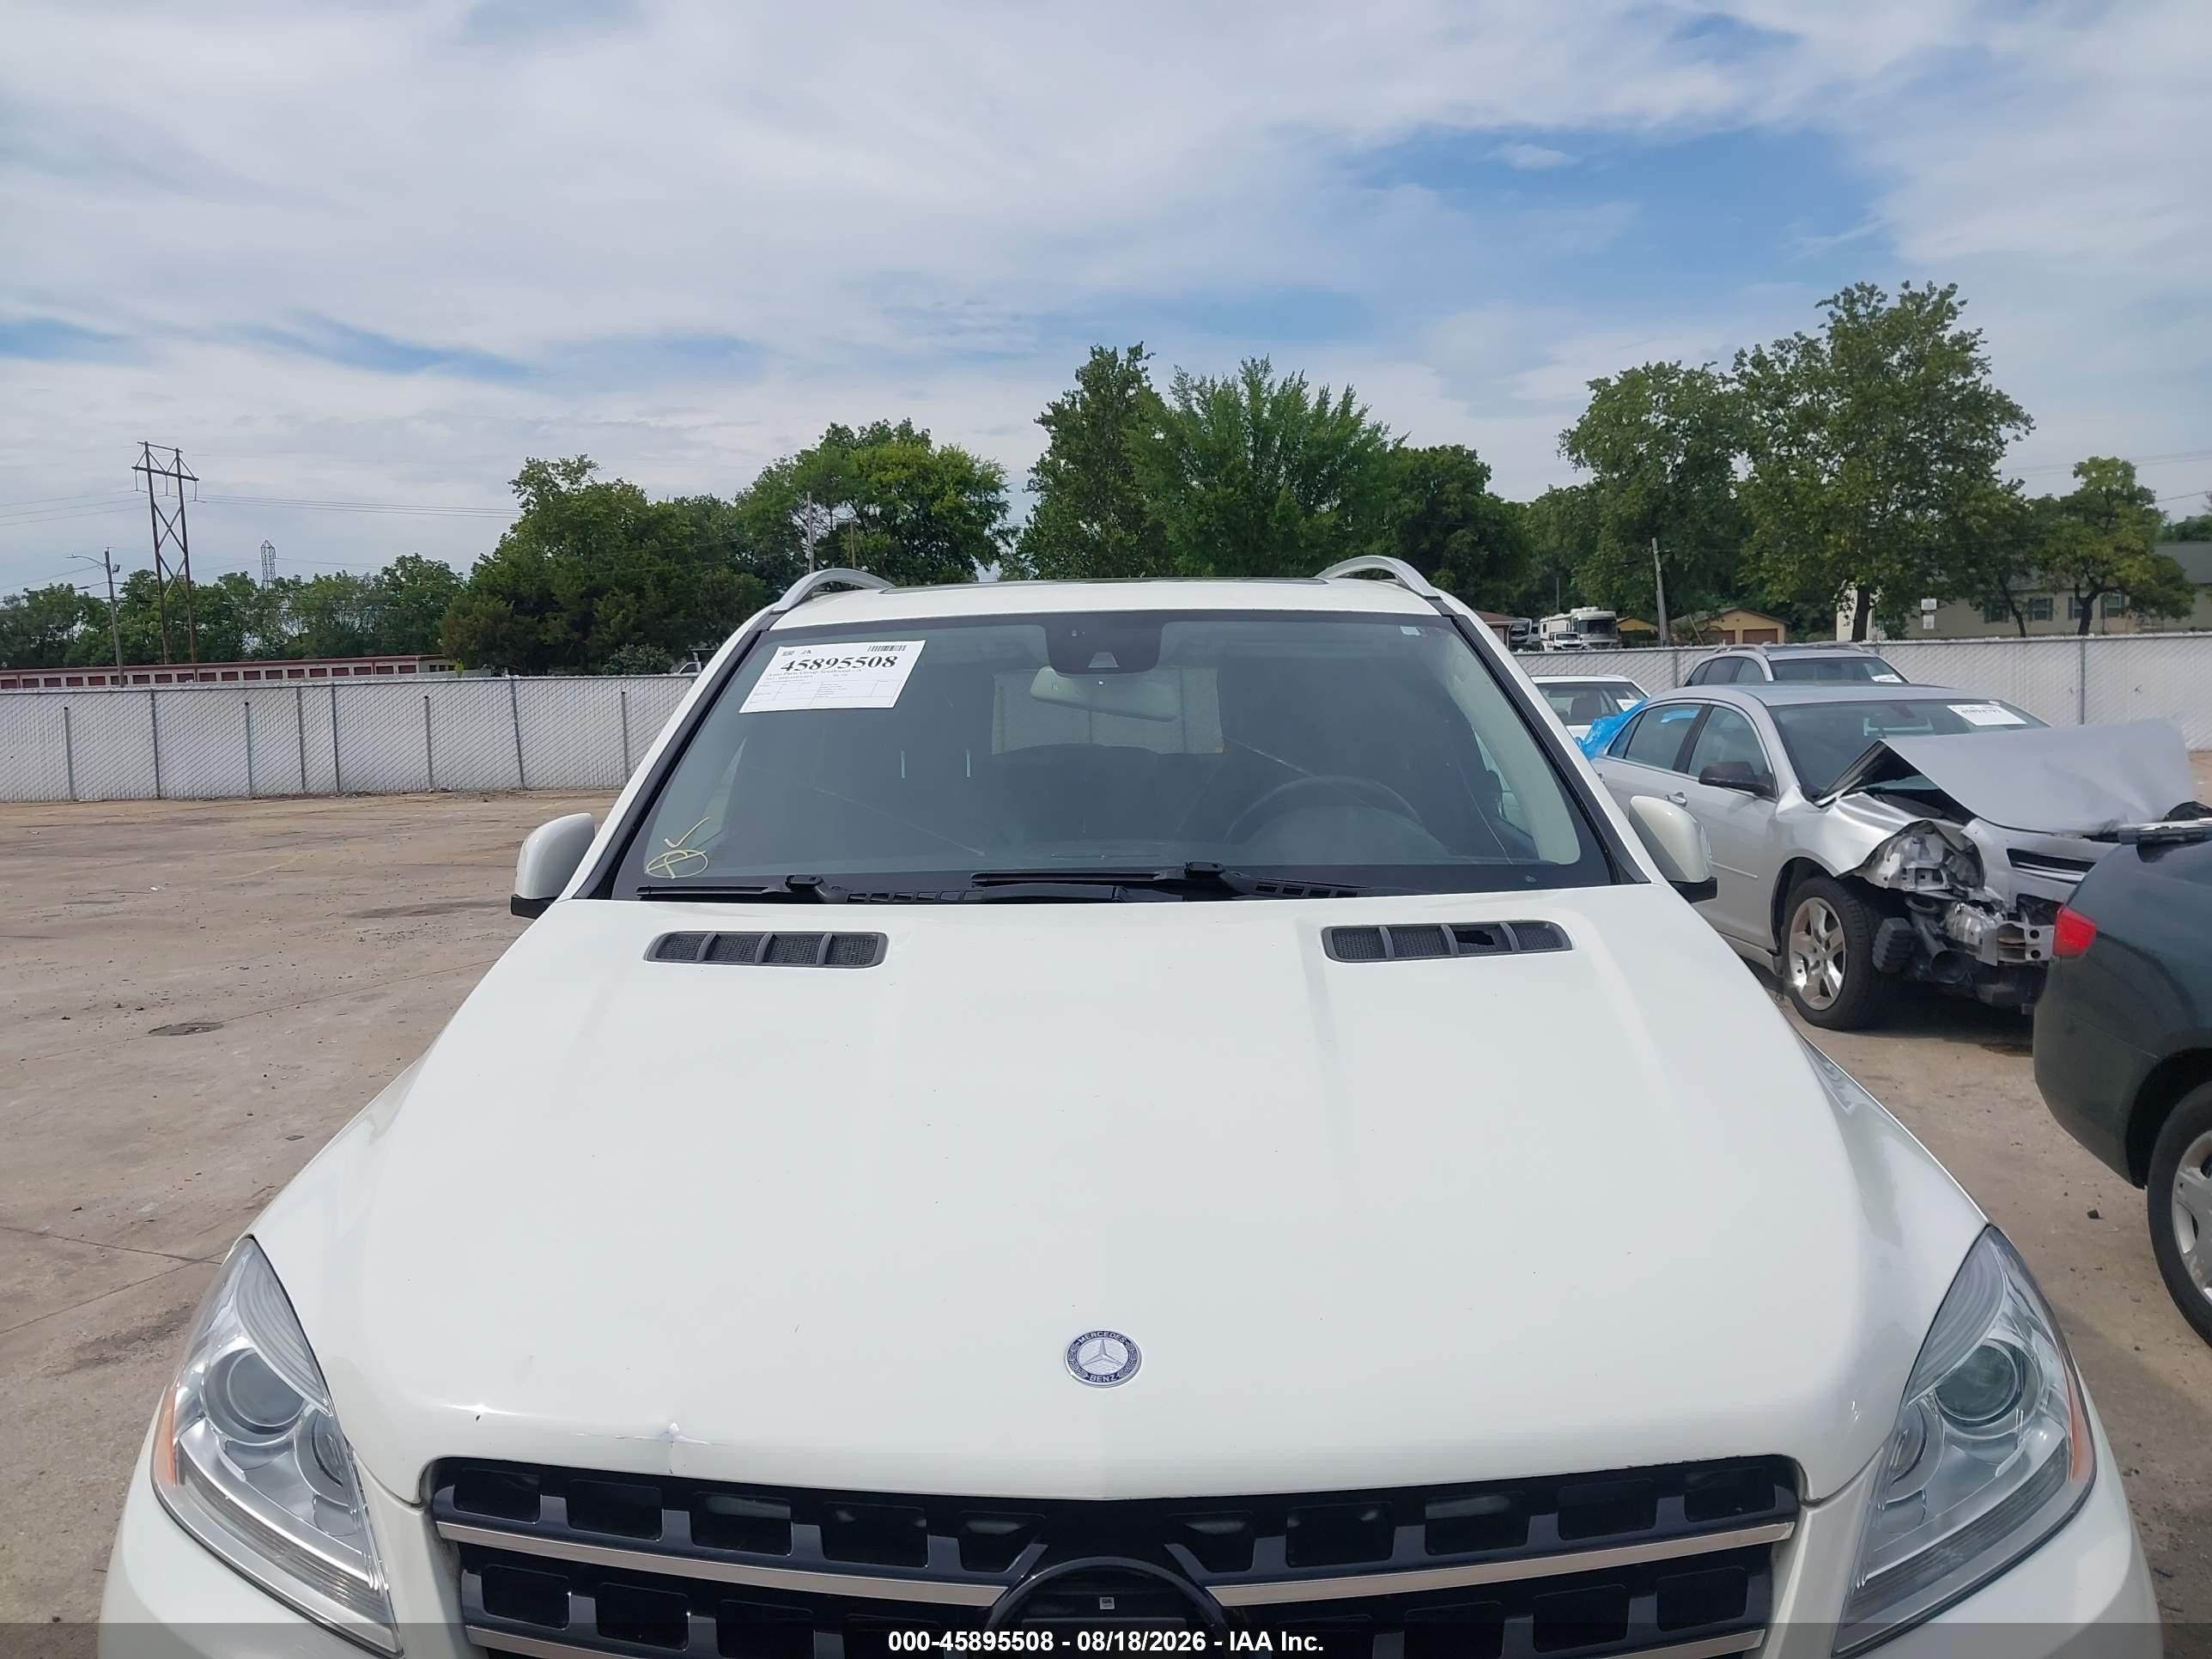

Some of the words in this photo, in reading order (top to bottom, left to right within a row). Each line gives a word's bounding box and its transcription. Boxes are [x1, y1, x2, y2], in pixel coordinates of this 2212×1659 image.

[780, 655, 899, 672] 45895508
[1077, 1331, 1127, 1344] MERCEDES
[1089, 1374, 1117, 1382] BENZ
